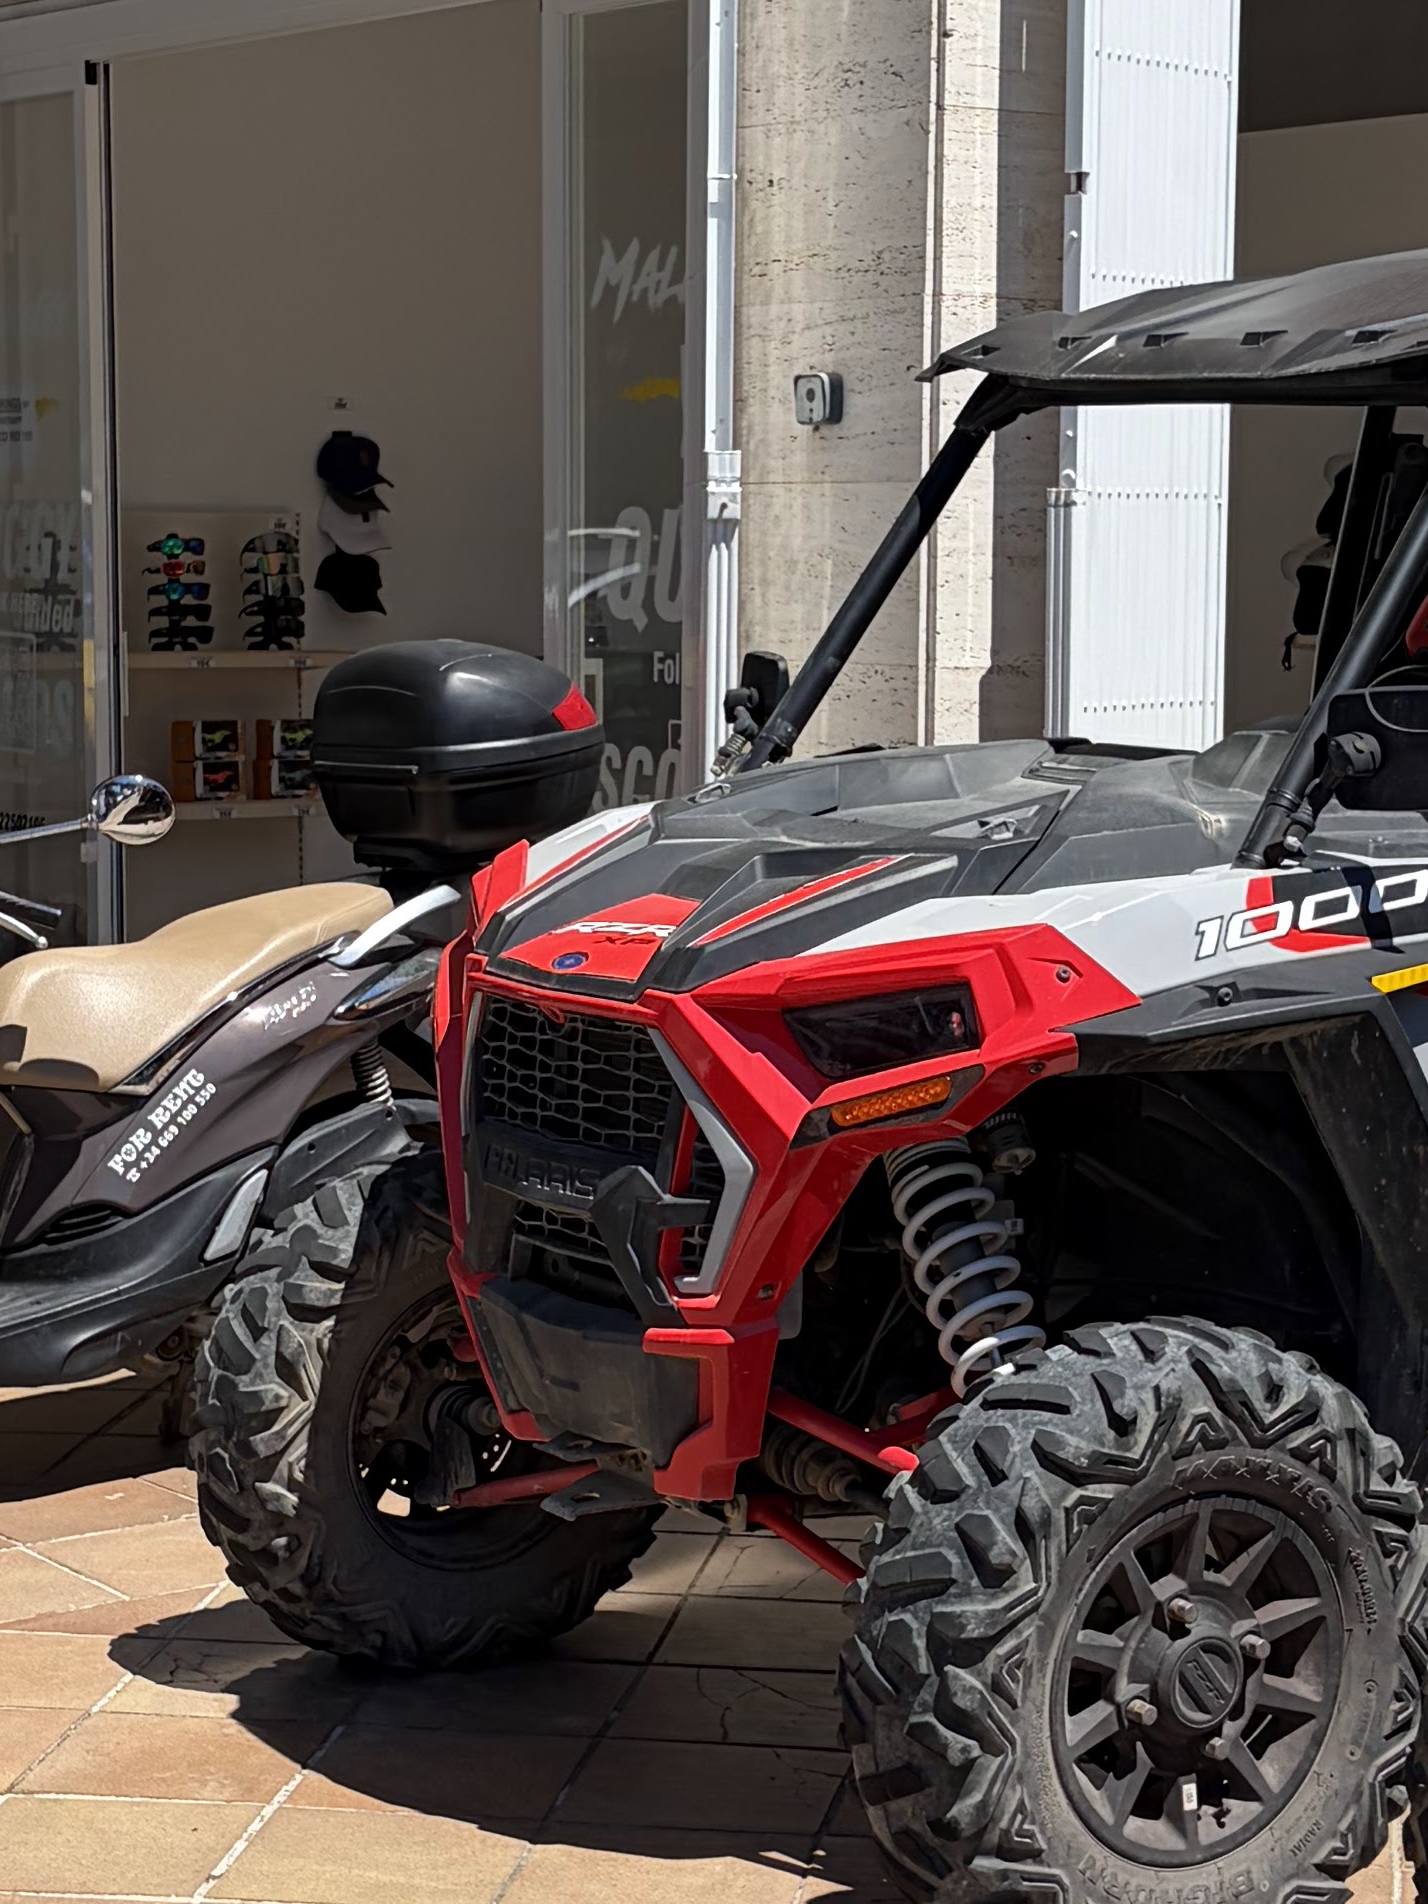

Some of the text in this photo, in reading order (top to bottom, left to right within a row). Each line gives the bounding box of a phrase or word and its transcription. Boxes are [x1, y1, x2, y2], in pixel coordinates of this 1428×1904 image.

[591, 232, 686, 326] MAL
[158, 1123, 180, 1148] 669
[176, 1103, 198, 1126] 100
[194, 1082, 217, 1107] 550
[107, 1127, 153, 1177] FOR
